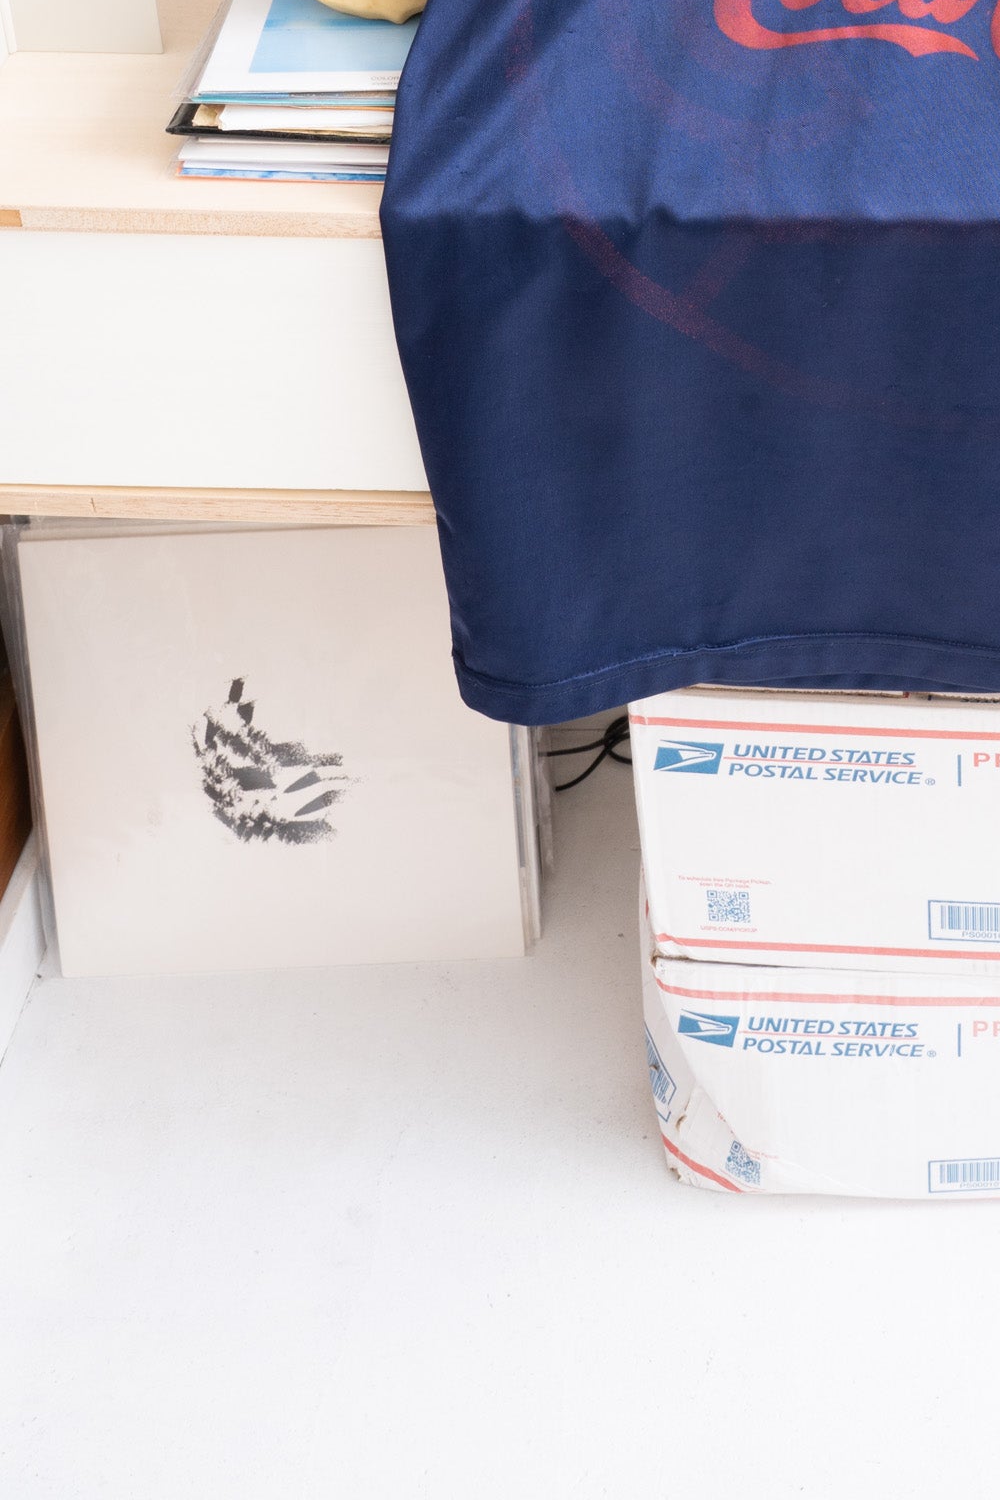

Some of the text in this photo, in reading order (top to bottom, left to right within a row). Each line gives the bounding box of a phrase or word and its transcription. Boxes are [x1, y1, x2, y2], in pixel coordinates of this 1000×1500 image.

[733, 744, 916, 765] UNITED STATES
[729, 763, 819, 781] POSTAL
[748, 1016, 919, 1037] UNITED STATES
[743, 1038, 827, 1056] POSTAL
